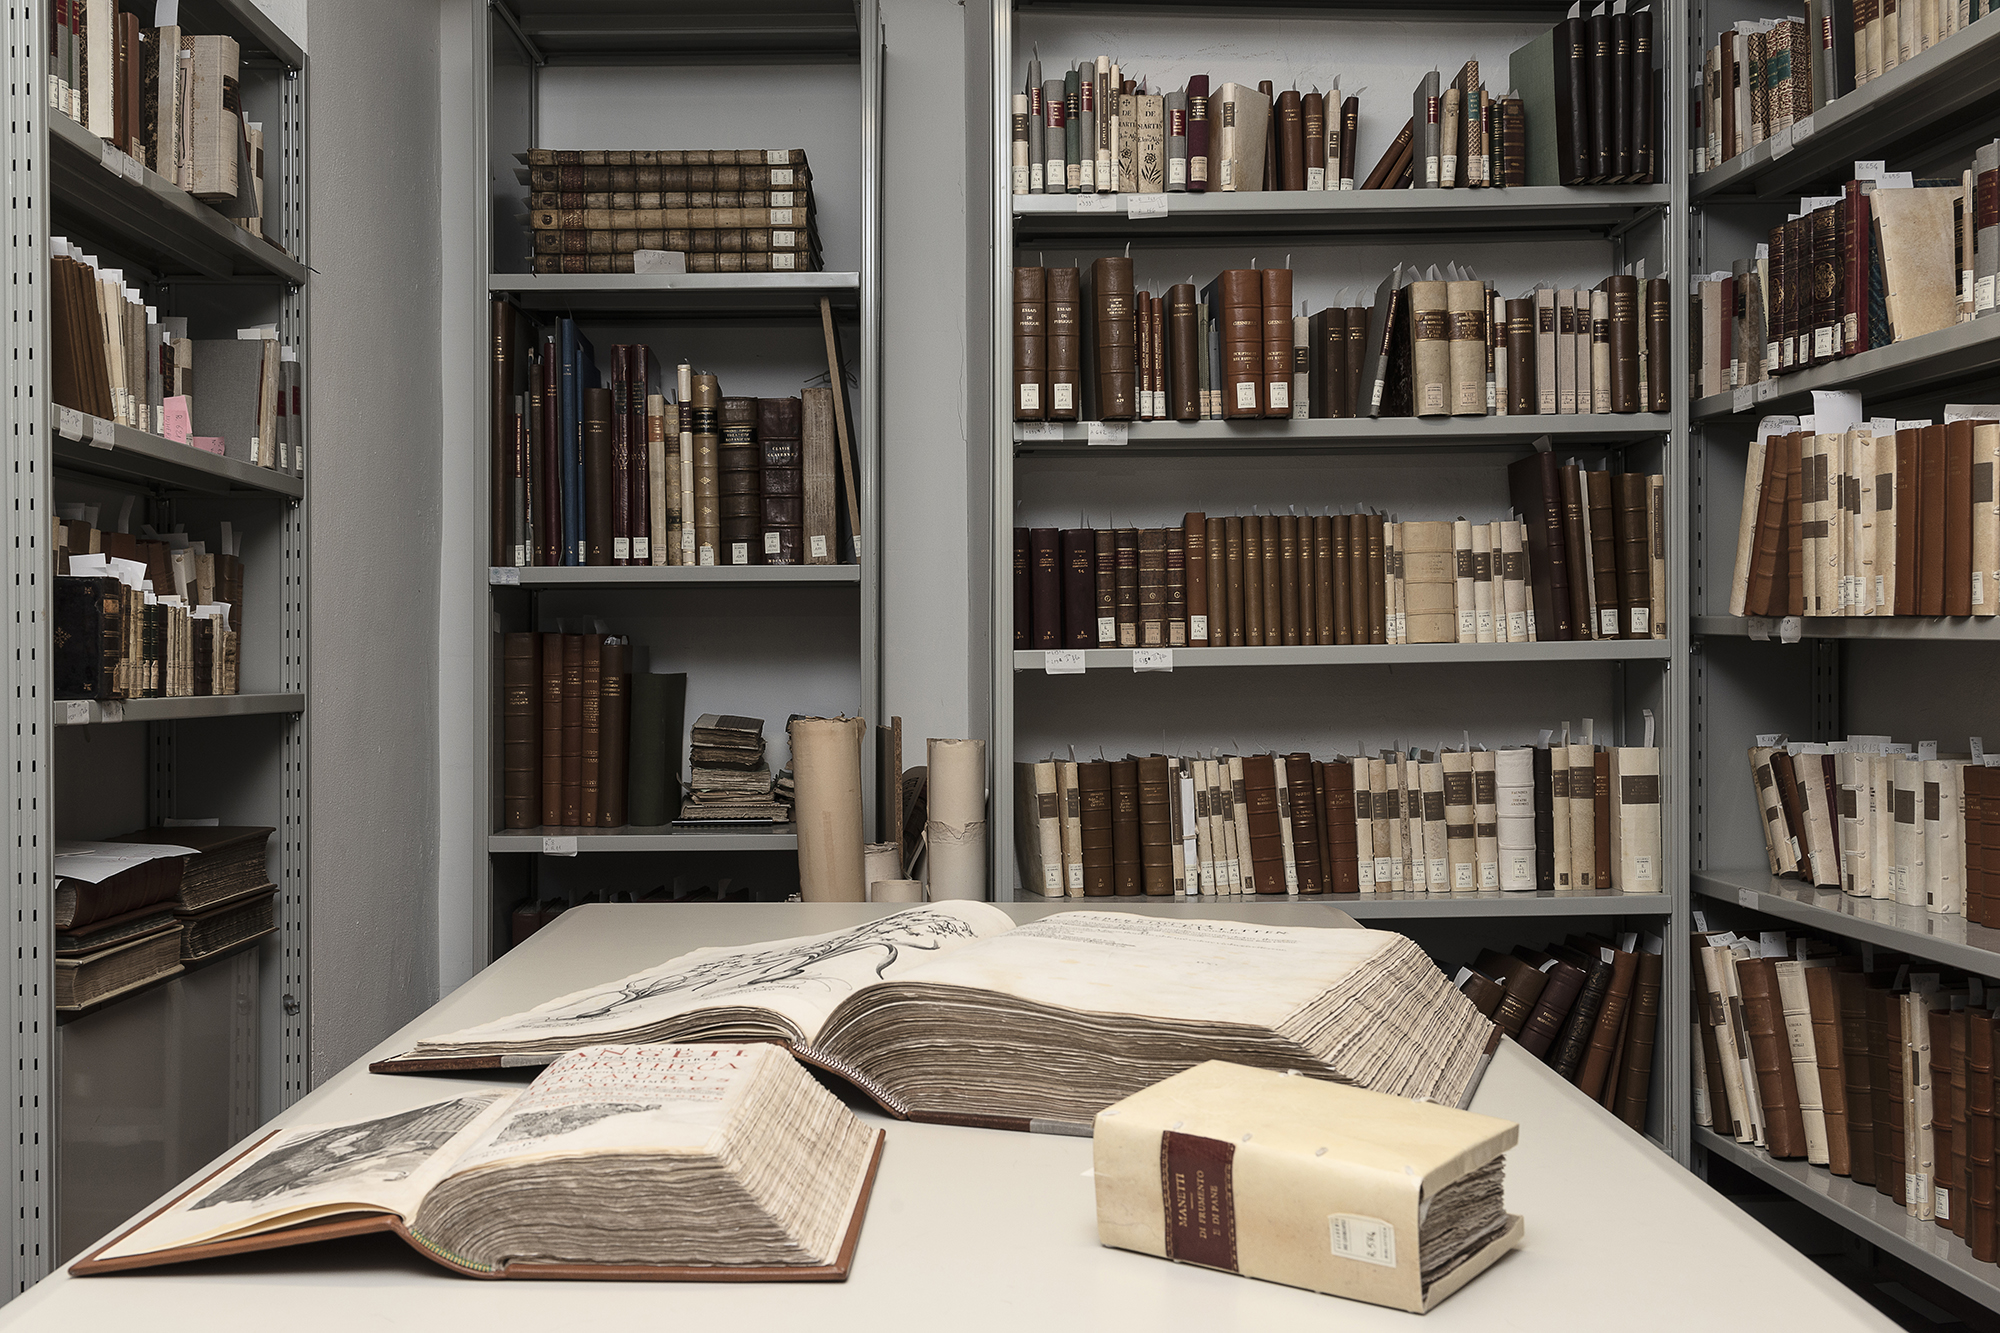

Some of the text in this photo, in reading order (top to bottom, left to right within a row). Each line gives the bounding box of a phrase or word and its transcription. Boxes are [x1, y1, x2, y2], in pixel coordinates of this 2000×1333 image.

[1175, 1173, 1188, 1227] MANETTI
[1196, 1170, 1208, 1239] DI FRUMENTO
[1210, 1185, 1219, 1213] PANE
[1211, 1213, 1219, 1225] DI
